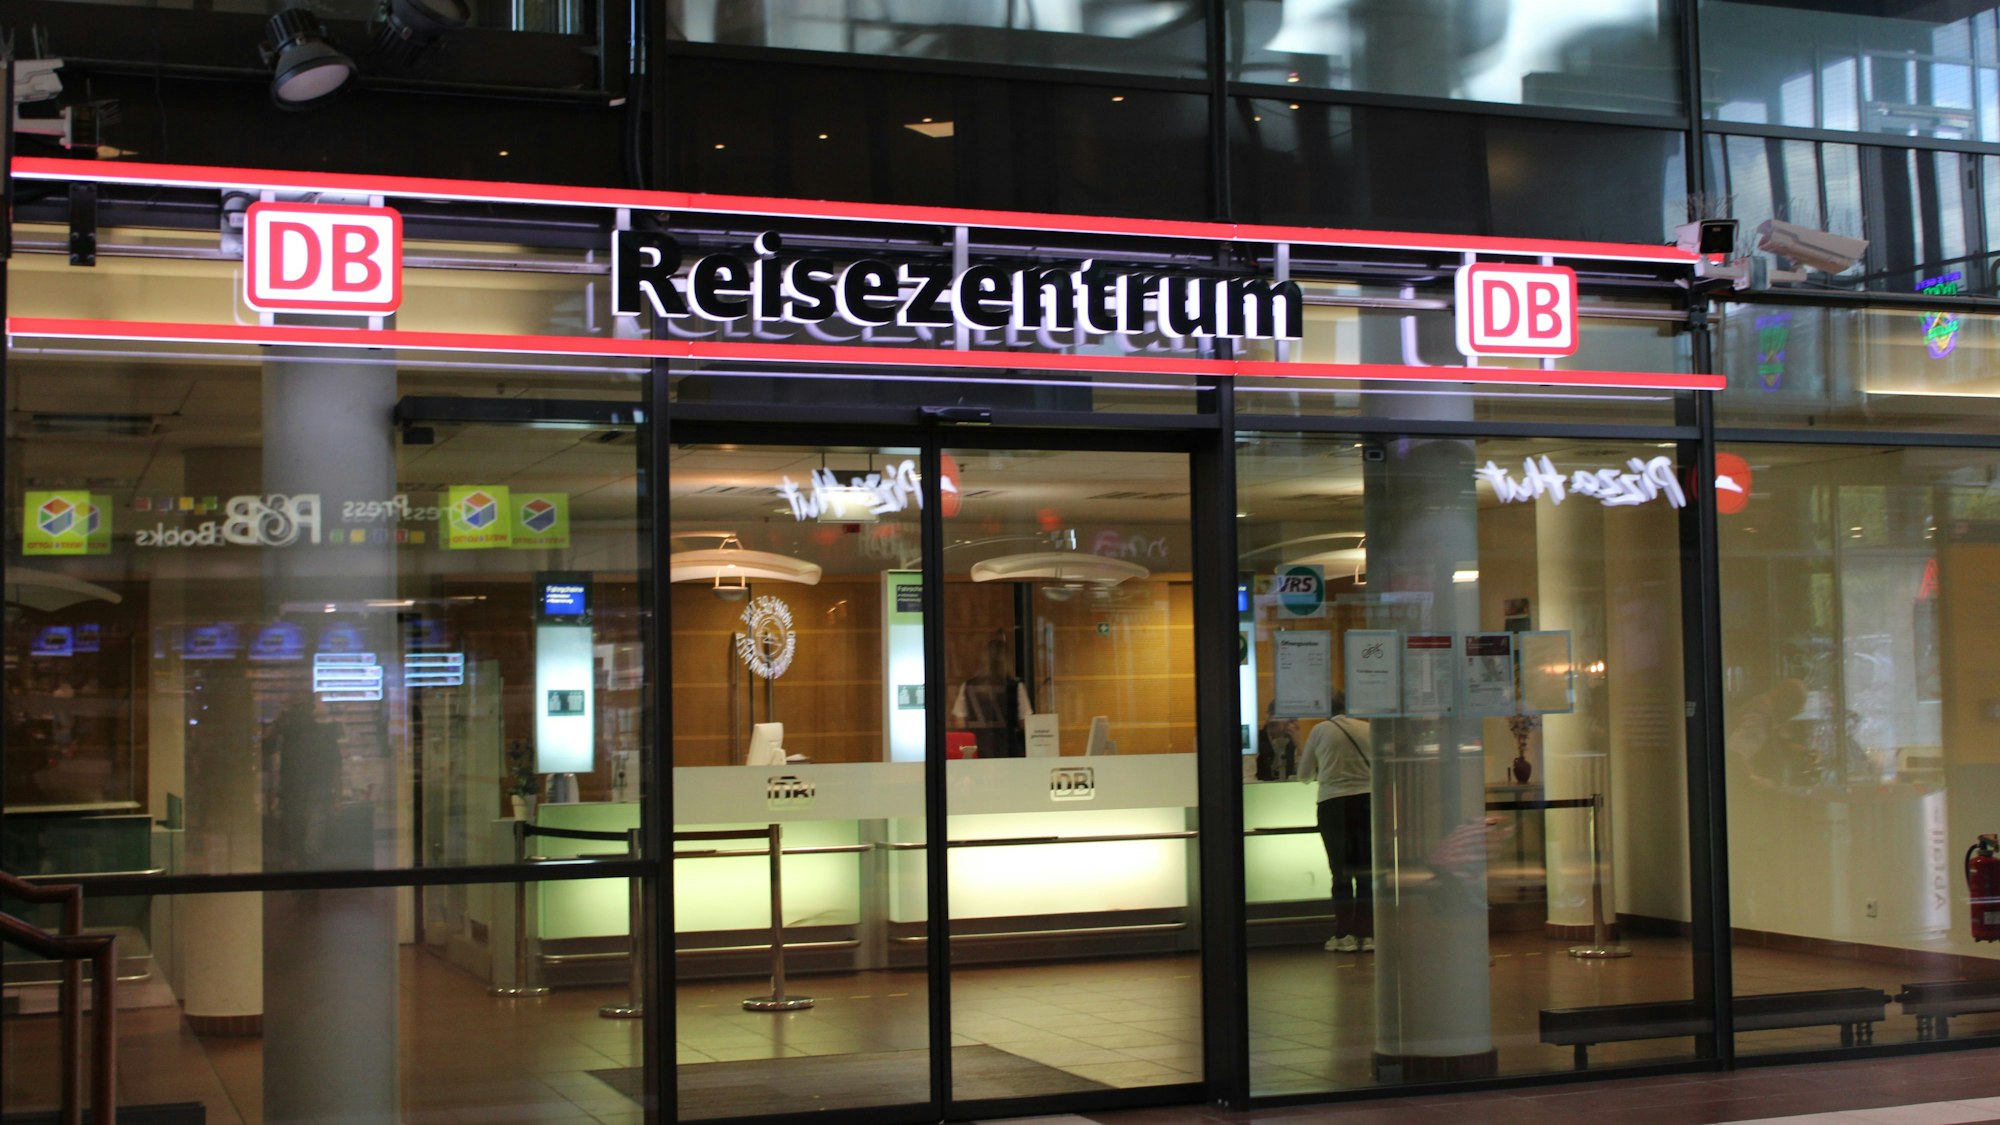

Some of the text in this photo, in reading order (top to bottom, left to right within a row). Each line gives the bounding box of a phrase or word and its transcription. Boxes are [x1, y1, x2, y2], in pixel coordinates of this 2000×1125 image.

[268, 222, 383, 292] DB
[611, 229, 1303, 341] Reisezentrum
[1481, 279, 1564, 339] DB
[1278, 576, 1313, 593] VRS
[1056, 772, 1090, 797] DB
